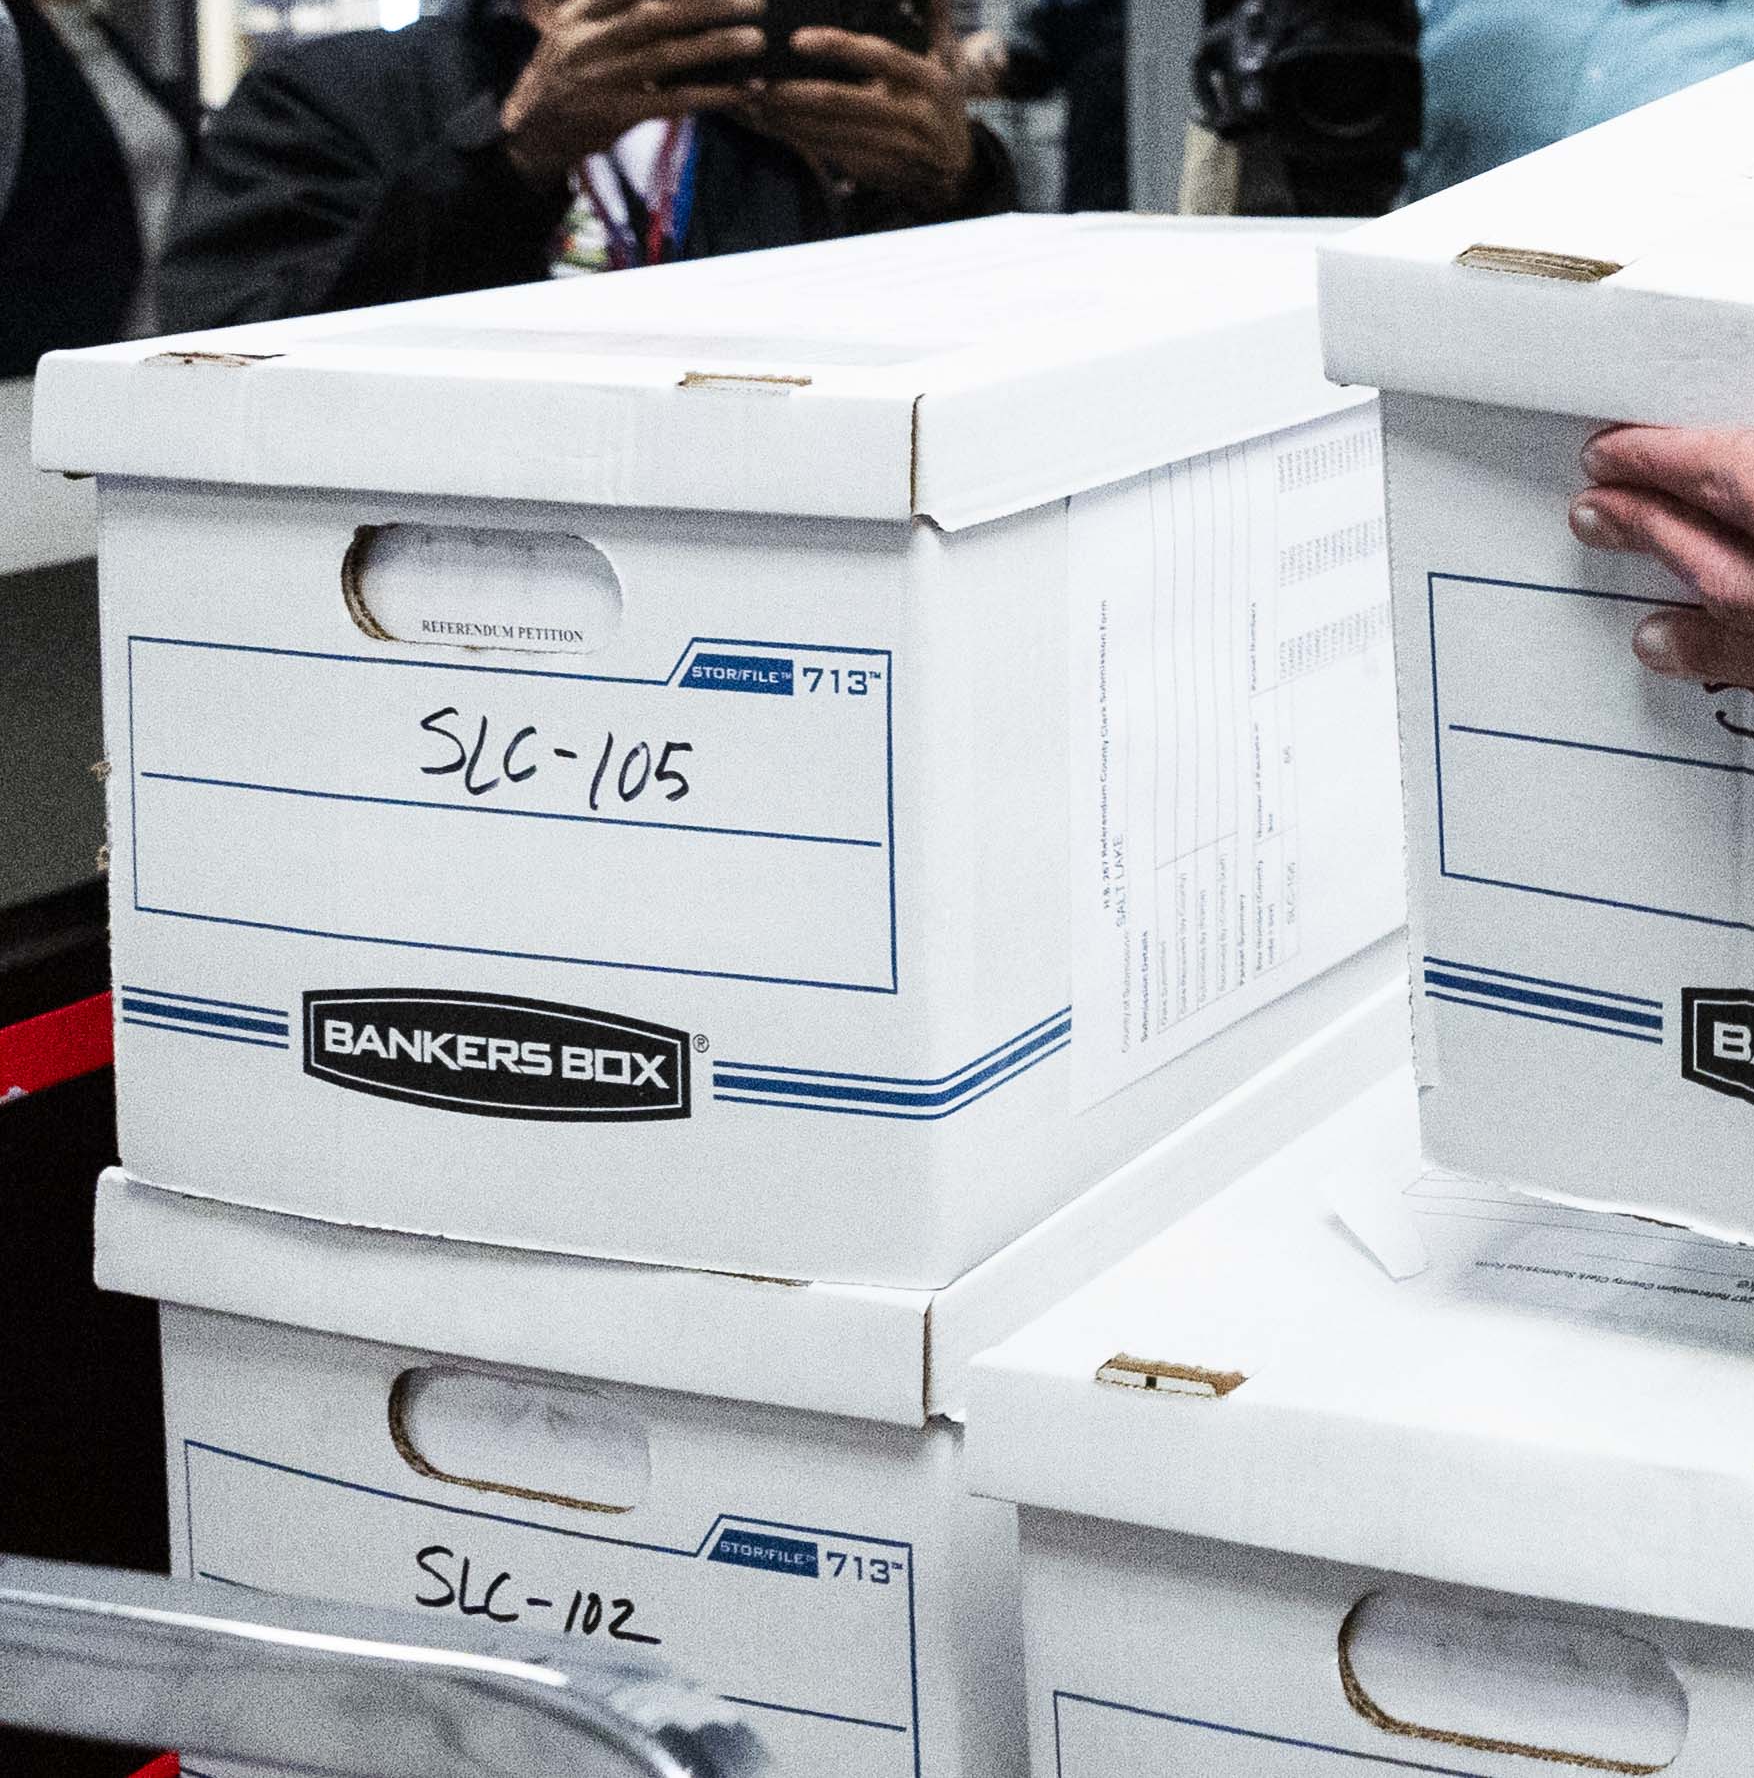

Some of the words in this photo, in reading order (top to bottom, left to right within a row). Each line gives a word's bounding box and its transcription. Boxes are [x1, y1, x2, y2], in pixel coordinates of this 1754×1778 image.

[420, 619, 515, 639] REFERENDUM
[517, 624, 585, 643] PETITION
[1099, 598, 1107, 631] Form
[1099, 633, 1108, 704] Submission
[1100, 705, 1109, 738] Clerk
[419, 706, 694, 811] SLC-105
[1100, 739, 1110, 783] County
[1100, 784, 1109, 859] Referendum
[1112, 833, 1126, 879] LAKE
[1113, 886, 1127, 928] SALT
[322, 1019, 553, 1077] BANKERS
[561, 1045, 670, 1090] BOX
[1475, 1259, 1507, 1270] Form
[1506, 1263, 1578, 1280] Submission
[1578, 1272, 1611, 1284] Clerk
[1611, 1276, 1656, 1291] County
[1656, 1284, 1731, 1300] Referendum
[415, 1544, 663, 1645] SLC-102
